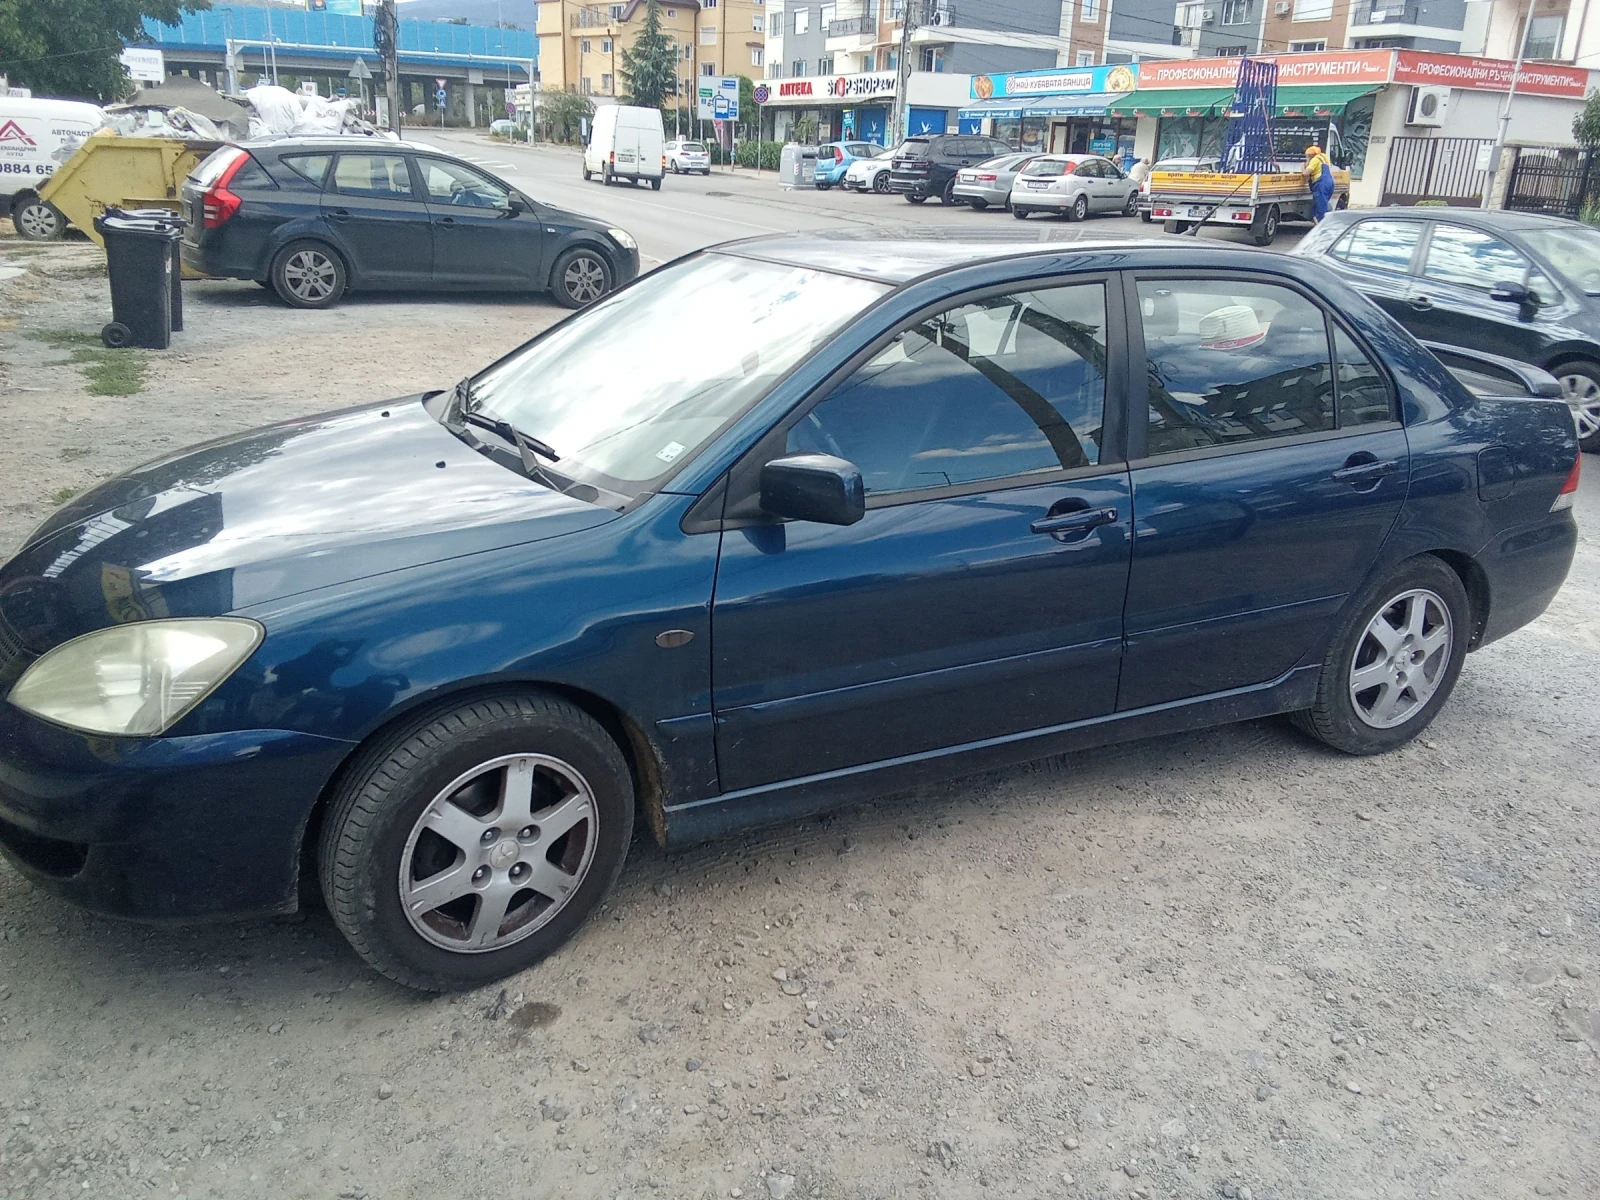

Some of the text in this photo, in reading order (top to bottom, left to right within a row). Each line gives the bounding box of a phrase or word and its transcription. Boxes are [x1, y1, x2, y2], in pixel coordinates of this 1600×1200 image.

[1157, 66, 1240, 81] ПРОФЕСИОНАЛНИ
[1279, 61, 1361, 77] ИНСТРУМЕНТИ
[1416, 62, 1488, 80] ПРОФЕСИОНАЛНИ
[1516, 72, 1569, 87] ИНСТРУМЕНТИ
[780, 82, 813, 96] АПТЕКА
[853, 77, 880, 95] SHOP
[1063, 77, 1091, 88] БАНИЦА
